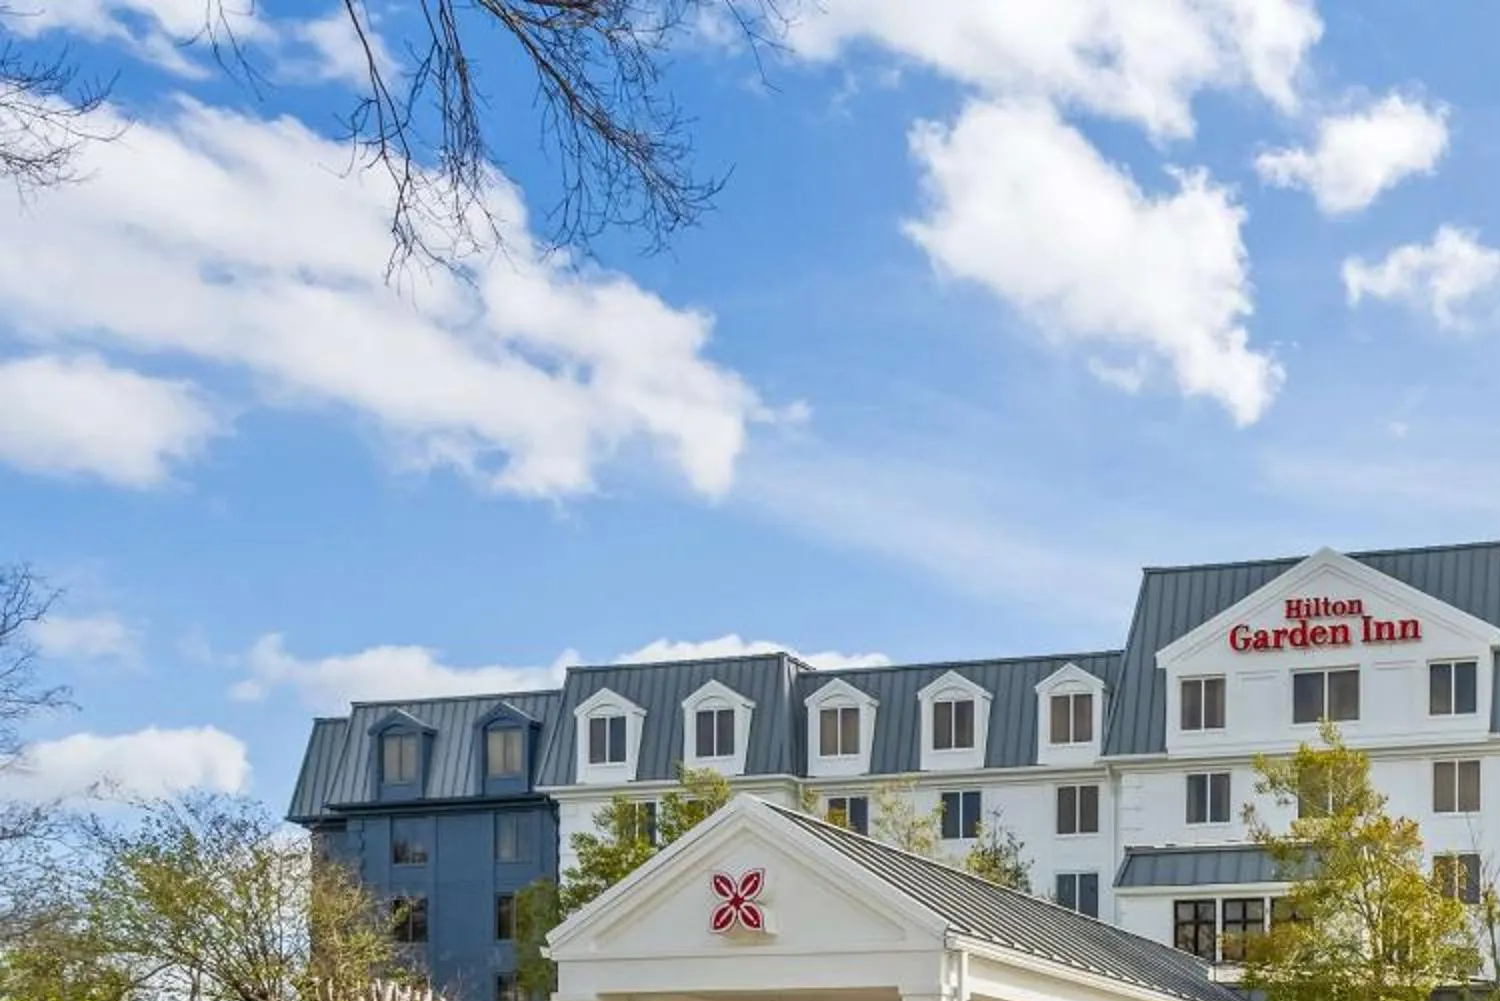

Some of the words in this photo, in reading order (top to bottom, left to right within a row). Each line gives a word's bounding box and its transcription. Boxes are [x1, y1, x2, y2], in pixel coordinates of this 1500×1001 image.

[1285, 597, 1364, 619] Hilton
[1230, 620, 1351, 651] Garden
[1361, 615, 1421, 643] Inn
